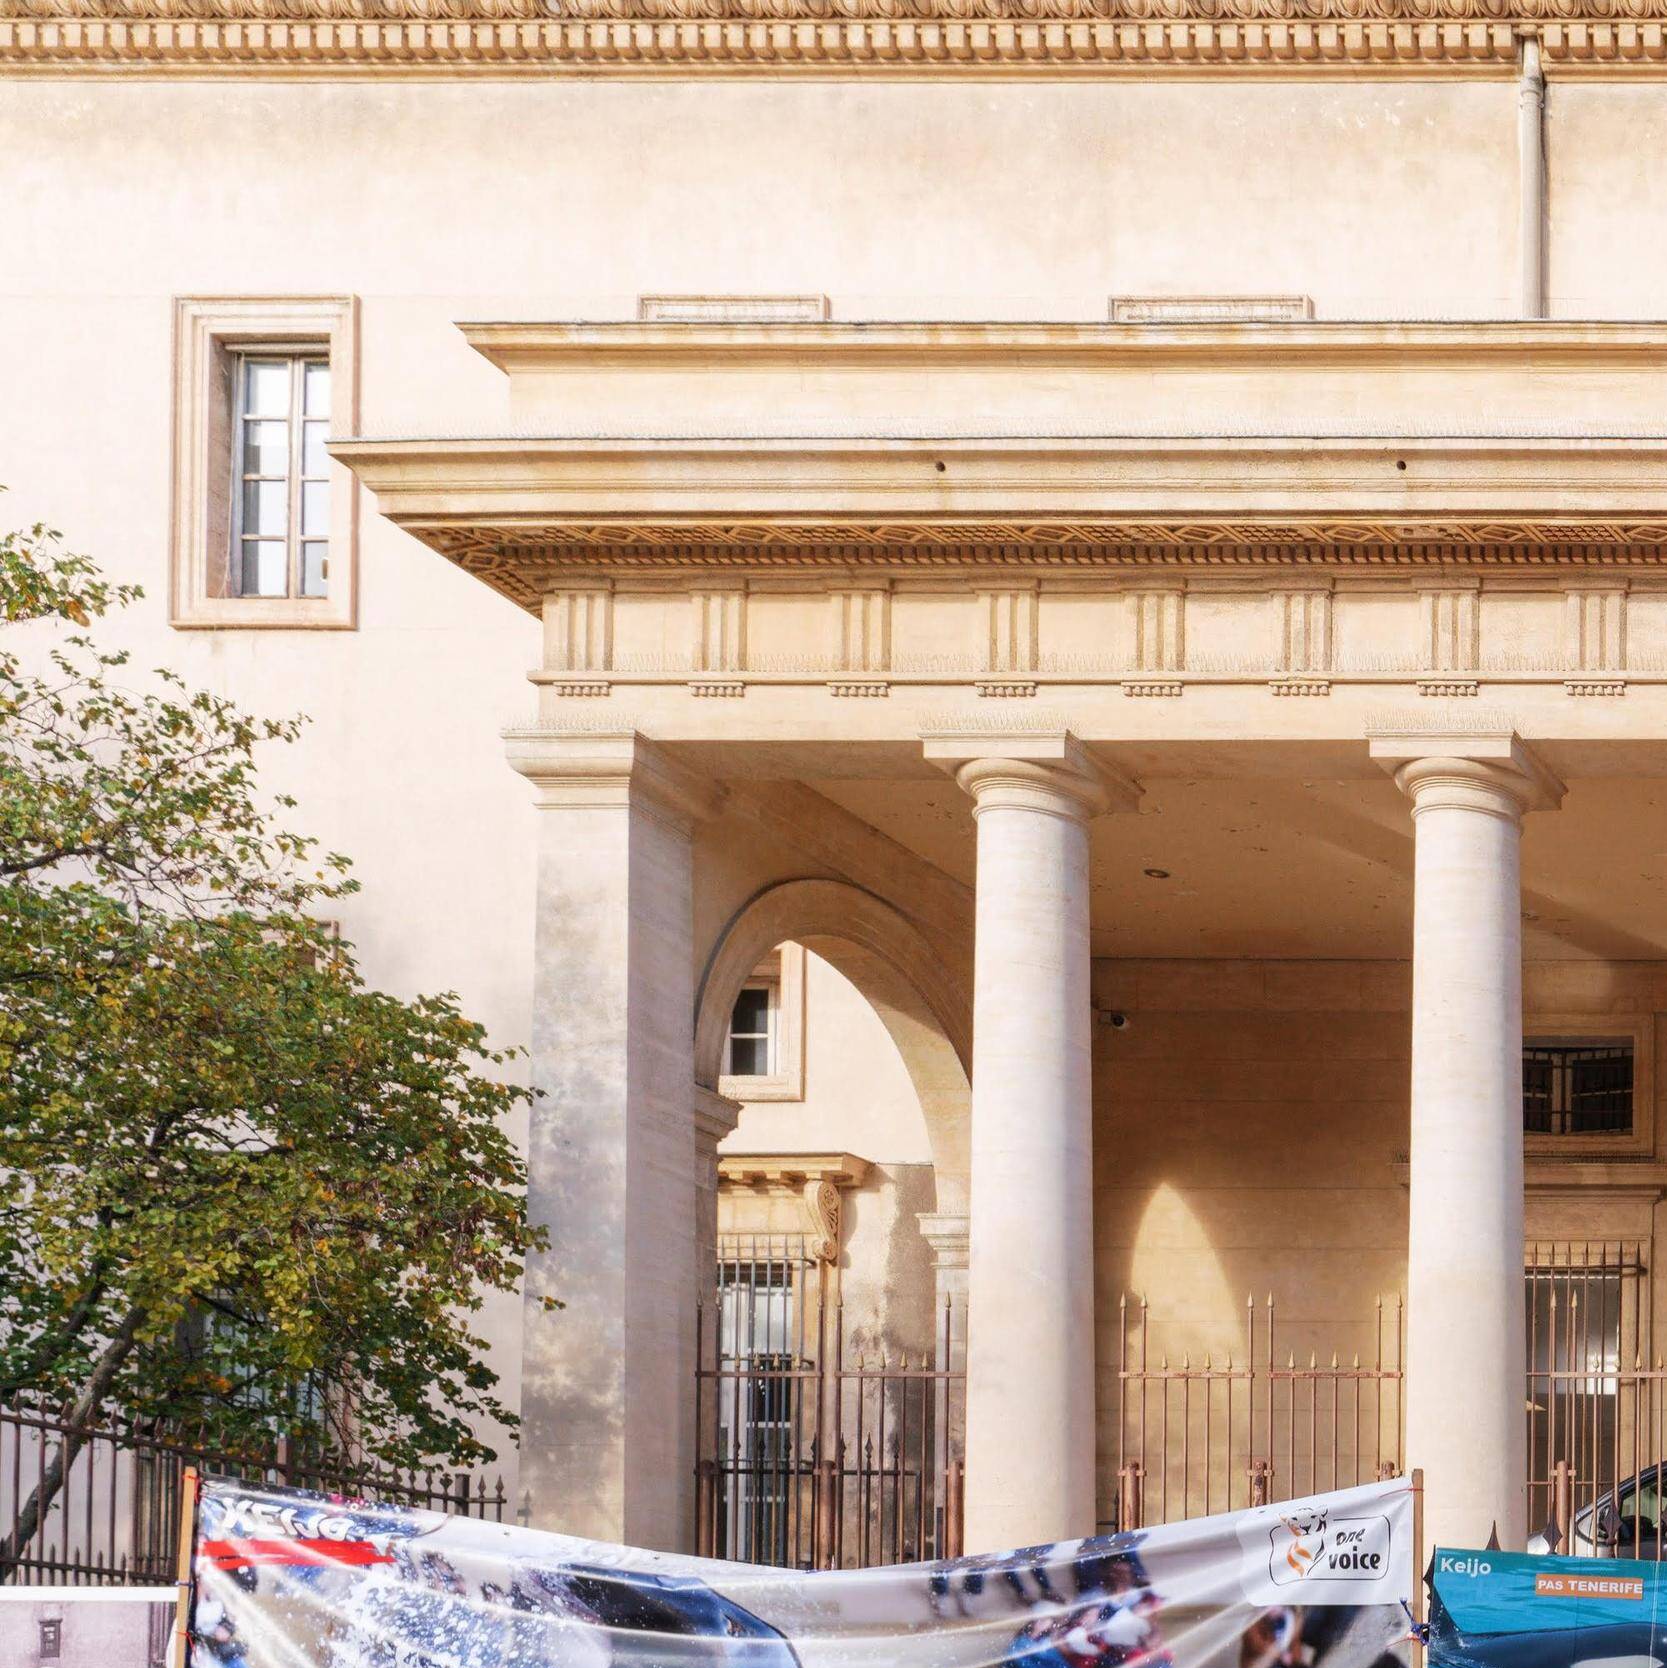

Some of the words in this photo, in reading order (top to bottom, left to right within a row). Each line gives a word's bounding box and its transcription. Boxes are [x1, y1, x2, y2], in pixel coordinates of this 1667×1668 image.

[1336, 1526, 1366, 1545] one
[1328, 1547, 1381, 1572] voice
[1440, 1556, 1492, 1578] Keijo
[1537, 1579, 1563, 1591] PAS
[1568, 1580, 1643, 1595] TENERIFE
